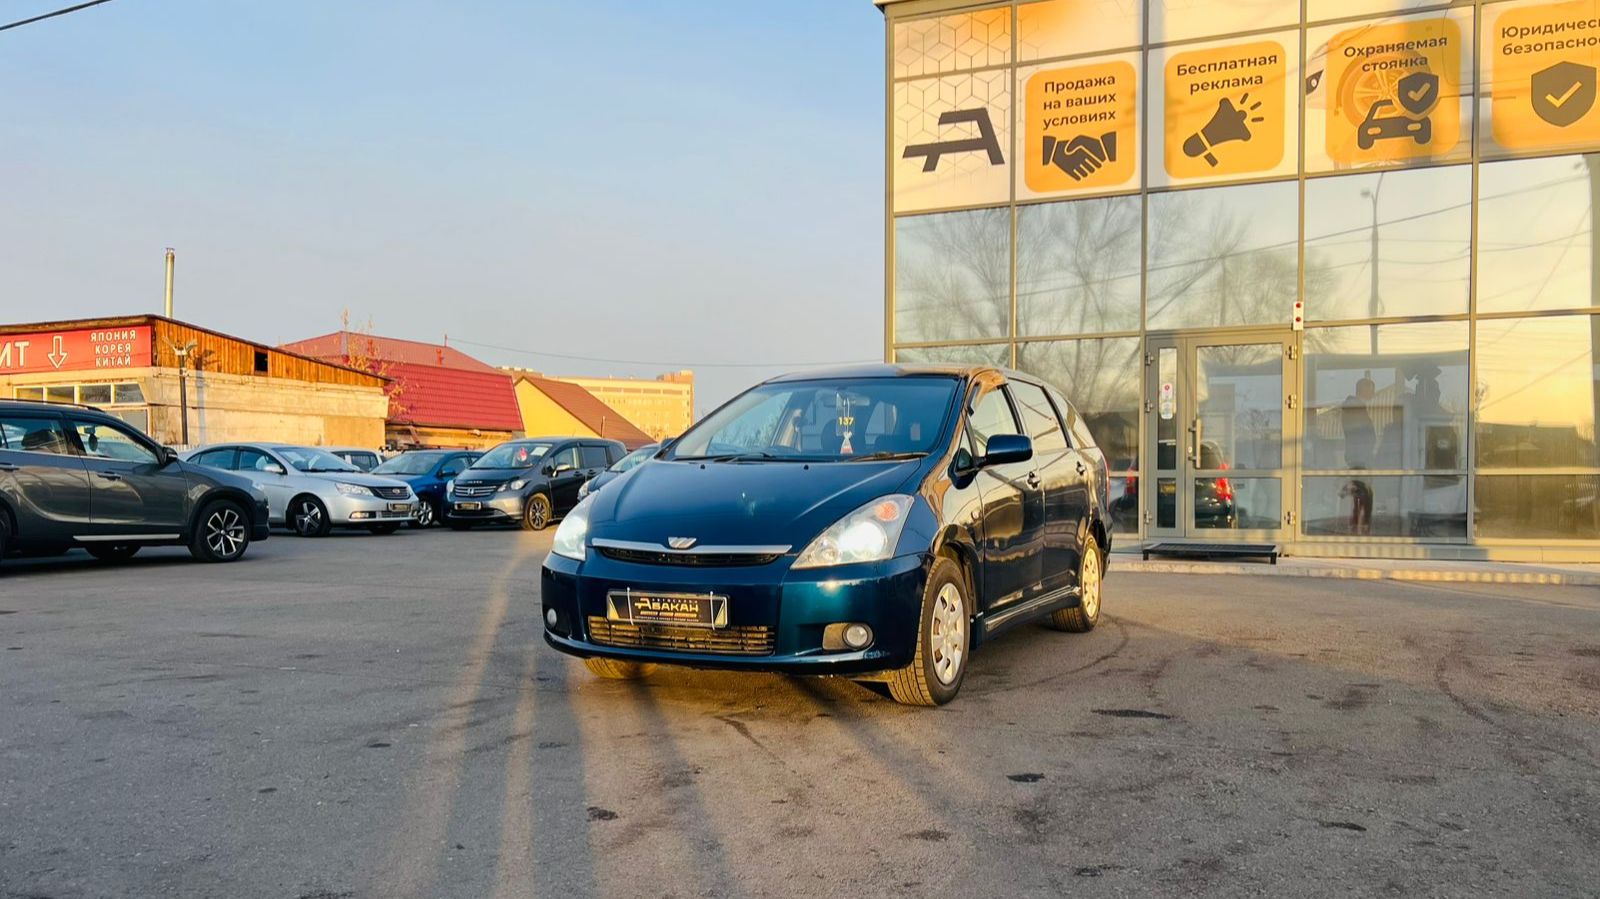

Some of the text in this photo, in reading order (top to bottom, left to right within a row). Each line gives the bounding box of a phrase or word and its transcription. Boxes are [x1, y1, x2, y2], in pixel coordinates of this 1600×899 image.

[1501, 18, 1600, 42] Юридичес
[1343, 36, 1448, 60] Охраняемая
[1502, 36, 1600, 56] безопасно
[1176, 54, 1278, 77] Бесплатная
[1361, 55, 1428, 73] стоянка
[1043, 74, 1116, 95] Продажа
[1189, 74, 1264, 96] реклама
[1043, 92, 1117, 111] на ваших
[1043, 110, 1117, 131] условиях
[90, 329, 137, 343] ЯПОНИЯ
[95, 342, 132, 355] КОРЕЯ
[95, 352, 132, 368] КИТАЙ
[838, 416, 854, 426] 137
